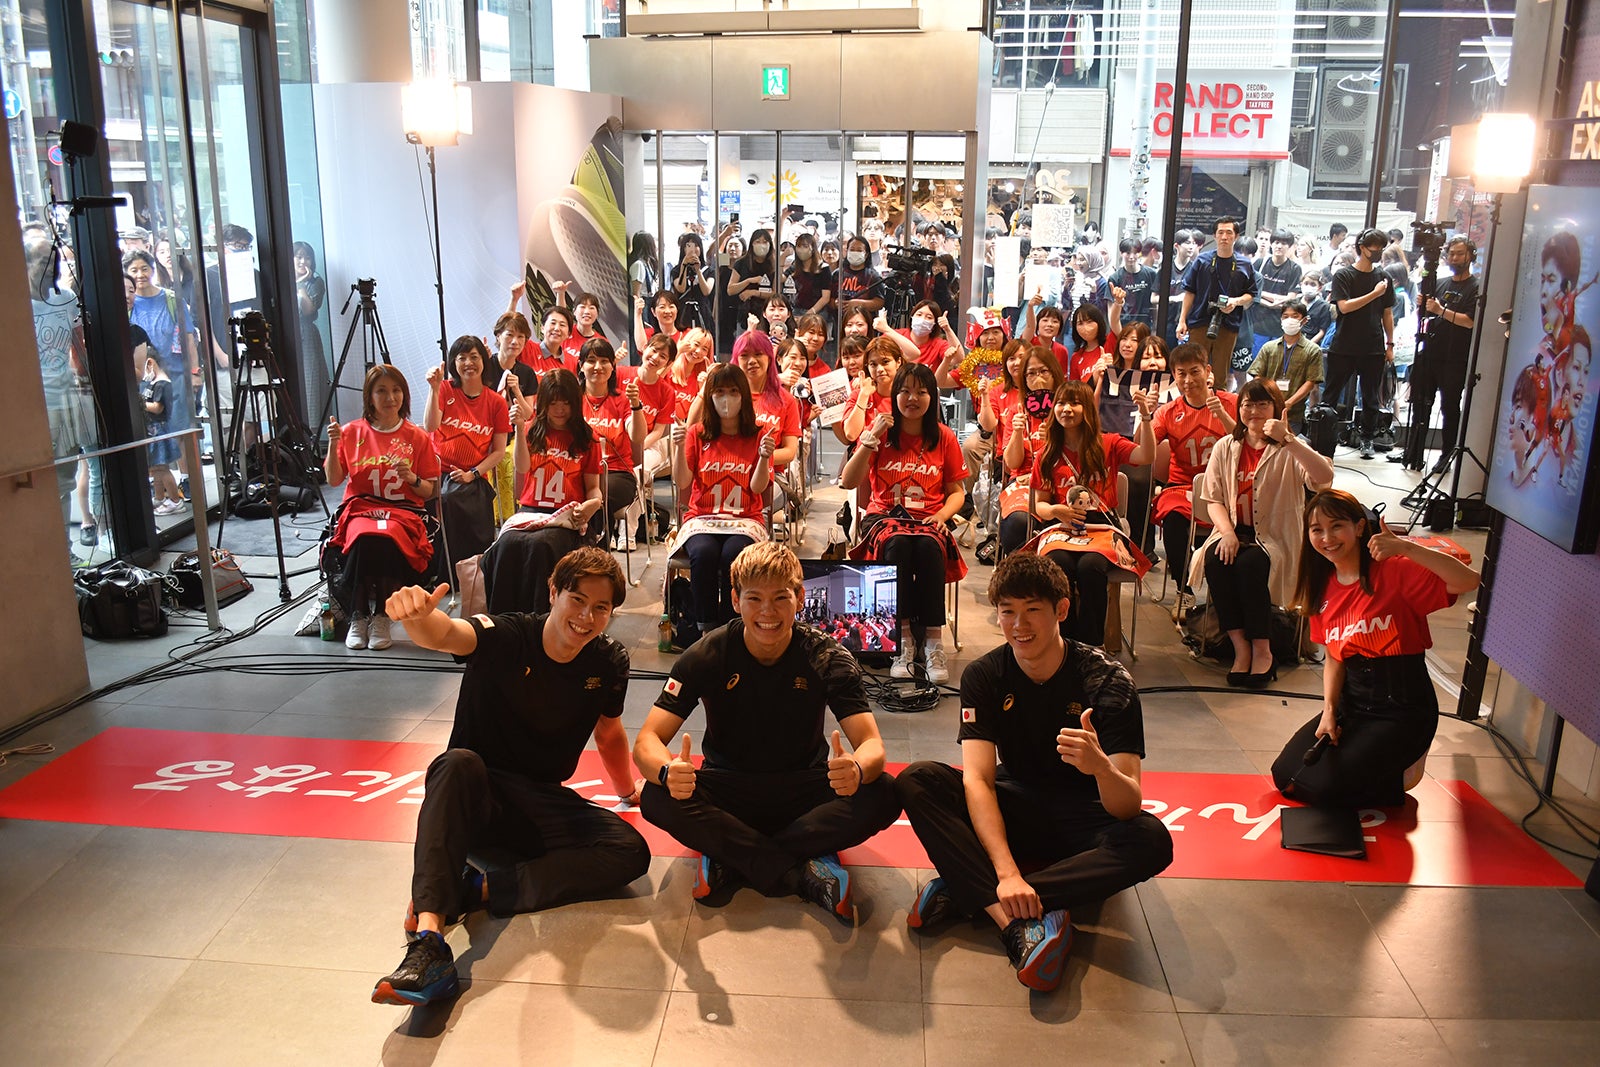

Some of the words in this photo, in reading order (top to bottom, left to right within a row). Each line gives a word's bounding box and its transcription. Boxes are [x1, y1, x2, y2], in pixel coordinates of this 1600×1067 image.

[1154, 82, 1244, 109] RAND
[1245, 91, 1261, 99] HAND
[1260, 91, 1275, 99] SHOP
[1246, 83, 1268, 92] SECOND
[1248, 101, 1258, 109] TAX
[1257, 101, 1271, 109] FREE
[1152, 112, 1273, 139] OLECT
[1231, 353, 1253, 370] Spor
[674, 390, 697, 403] APAN
[1104, 366, 1183, 404] YUK
[440, 416, 494, 437] JAPAN
[582, 416, 622, 430] APAN
[1184, 435, 1216, 468] 12
[879, 460, 940, 477] JAPAN
[367, 468, 406, 501] 12
[533, 467, 566, 503] 14
[889, 483, 926, 509] 12
[710, 483, 745, 515] 14
[1323, 614, 1393, 646] JAPAN
